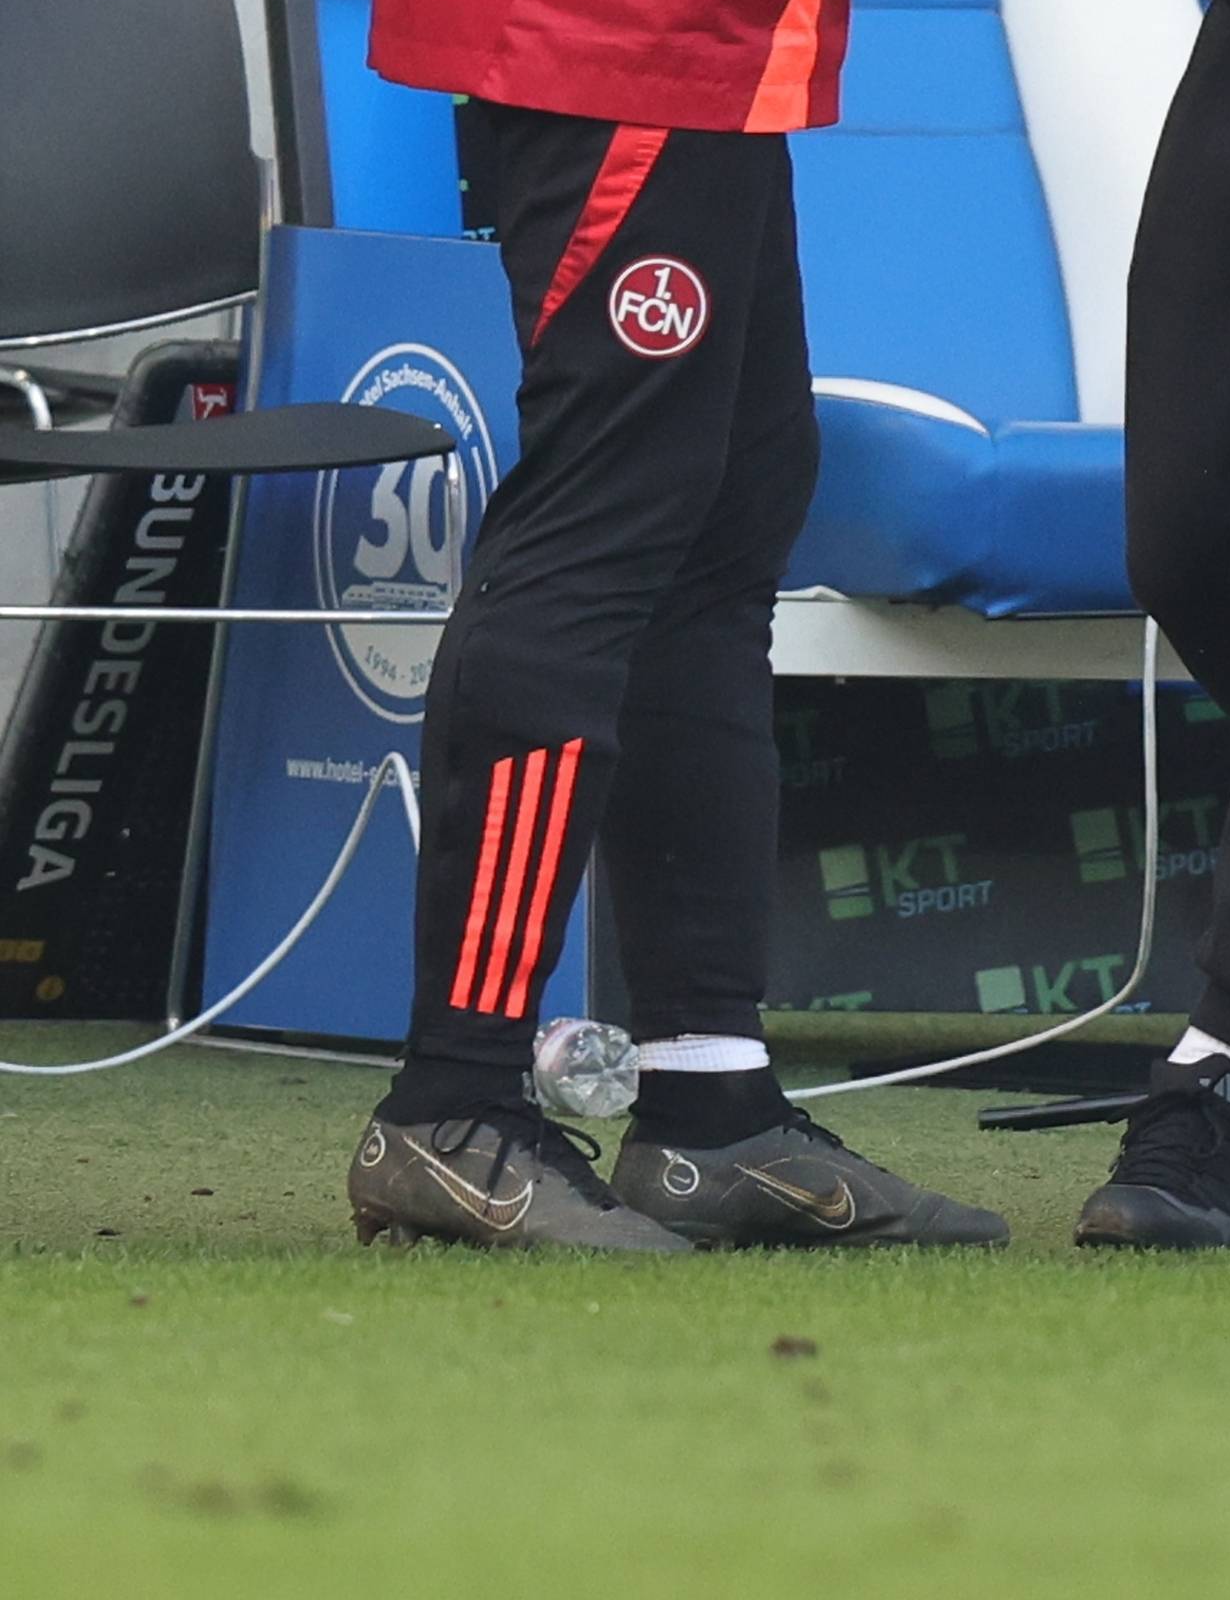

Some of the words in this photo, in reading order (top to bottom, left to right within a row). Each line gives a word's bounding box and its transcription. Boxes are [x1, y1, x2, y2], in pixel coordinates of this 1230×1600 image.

[617, 289, 694, 340] FCN
[353, 454, 467, 584] 30
[16, 474, 206, 893] BUNDESLIGA
[877, 834, 968, 908] KT
[898, 880, 994, 918] SPORT
